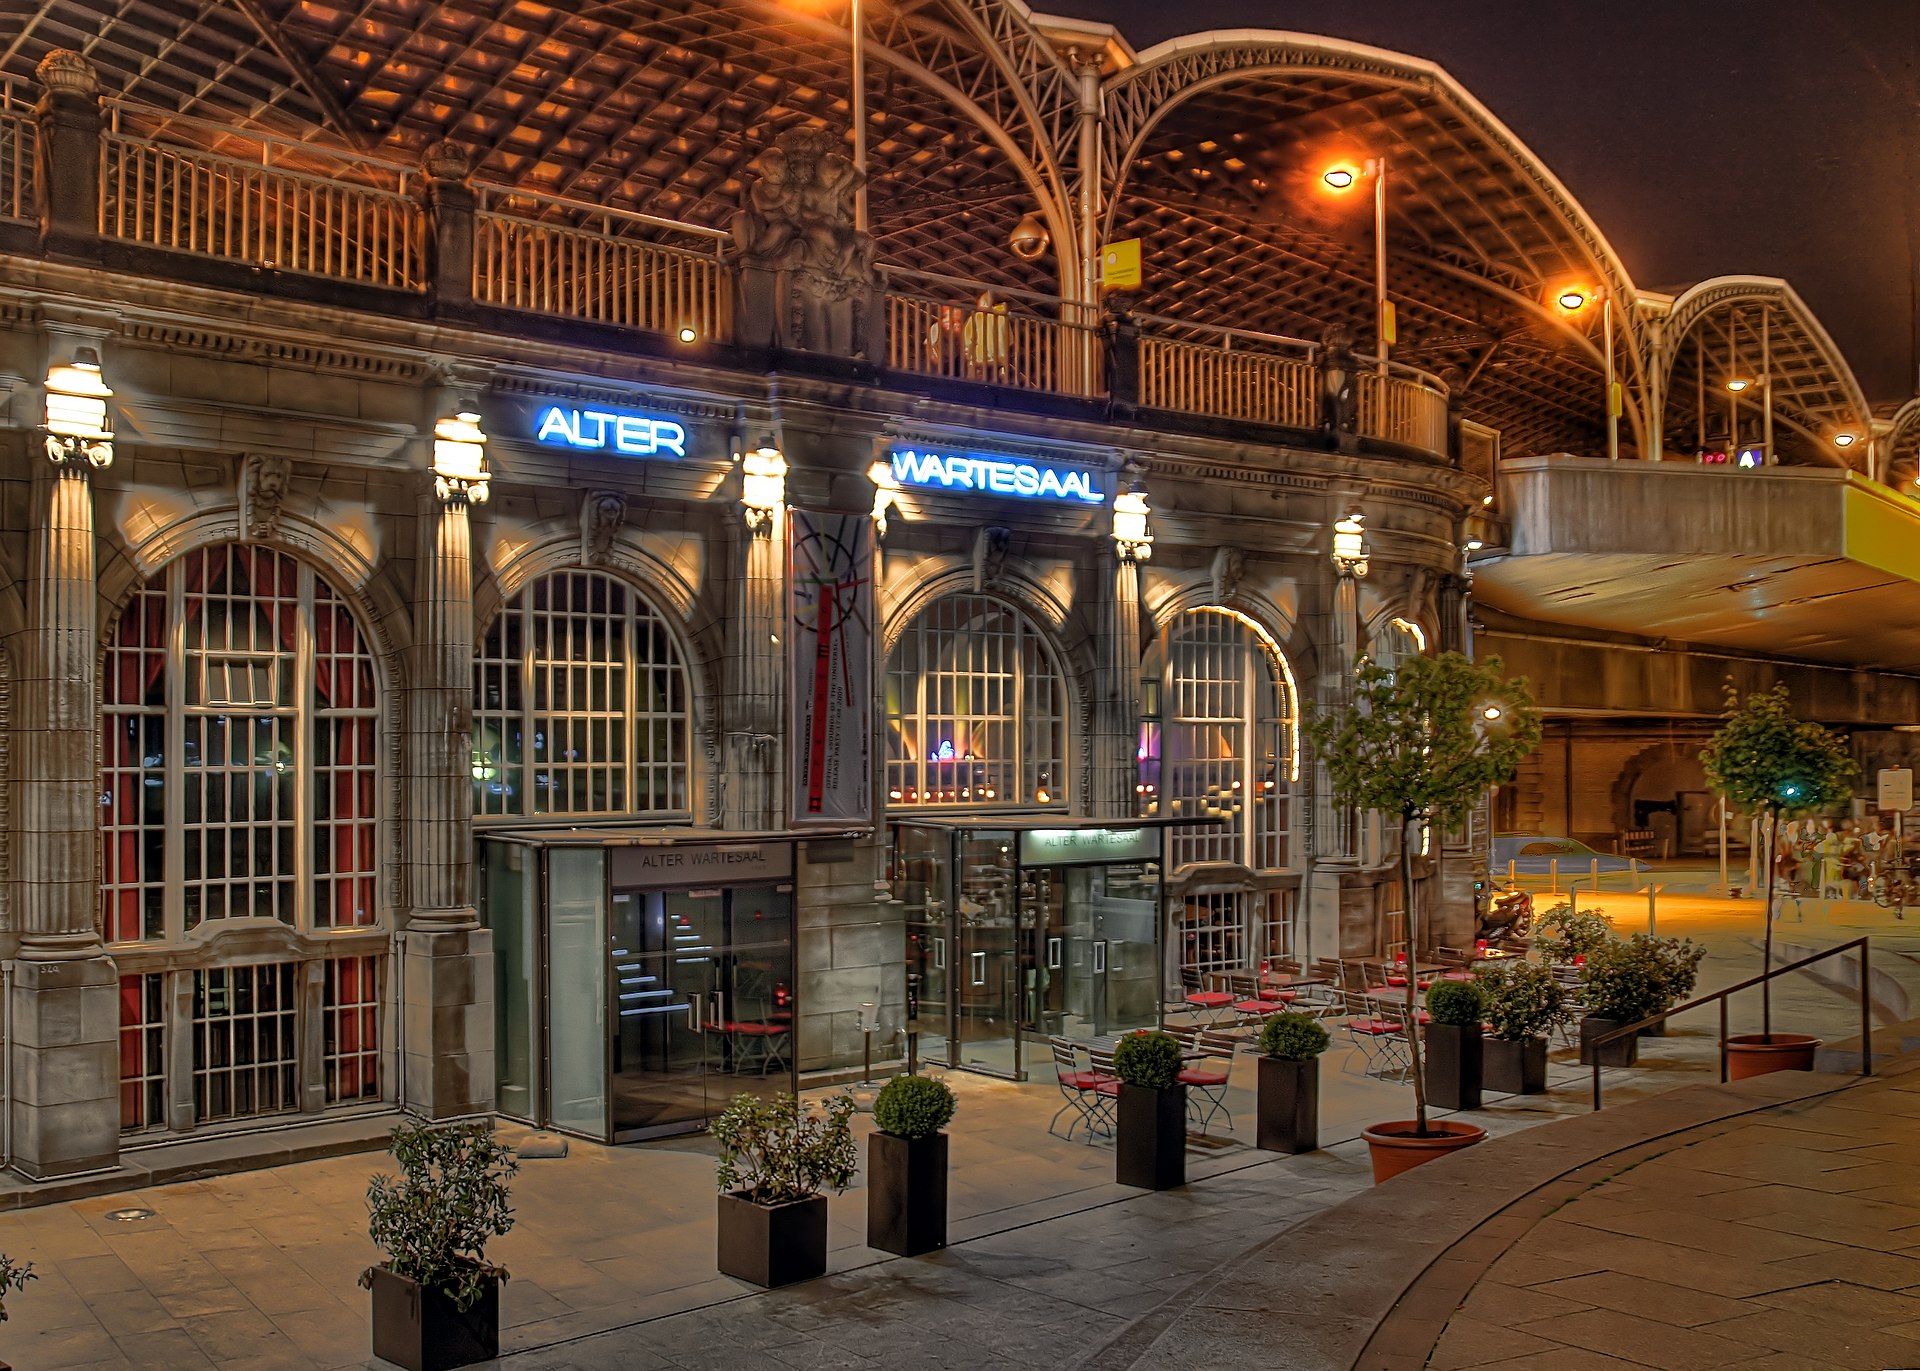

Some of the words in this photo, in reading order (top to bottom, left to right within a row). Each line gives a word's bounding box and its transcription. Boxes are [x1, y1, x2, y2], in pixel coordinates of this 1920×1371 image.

[537, 405, 686, 458] ALTER
[892, 449, 1105, 503] WARTESAAL
[1045, 835, 1077, 847] ALTER
[1082, 832, 1141, 846] WARTESAAL
[642, 853, 684, 868] ALTER
[691, 850, 767, 865] WARTESAAL
